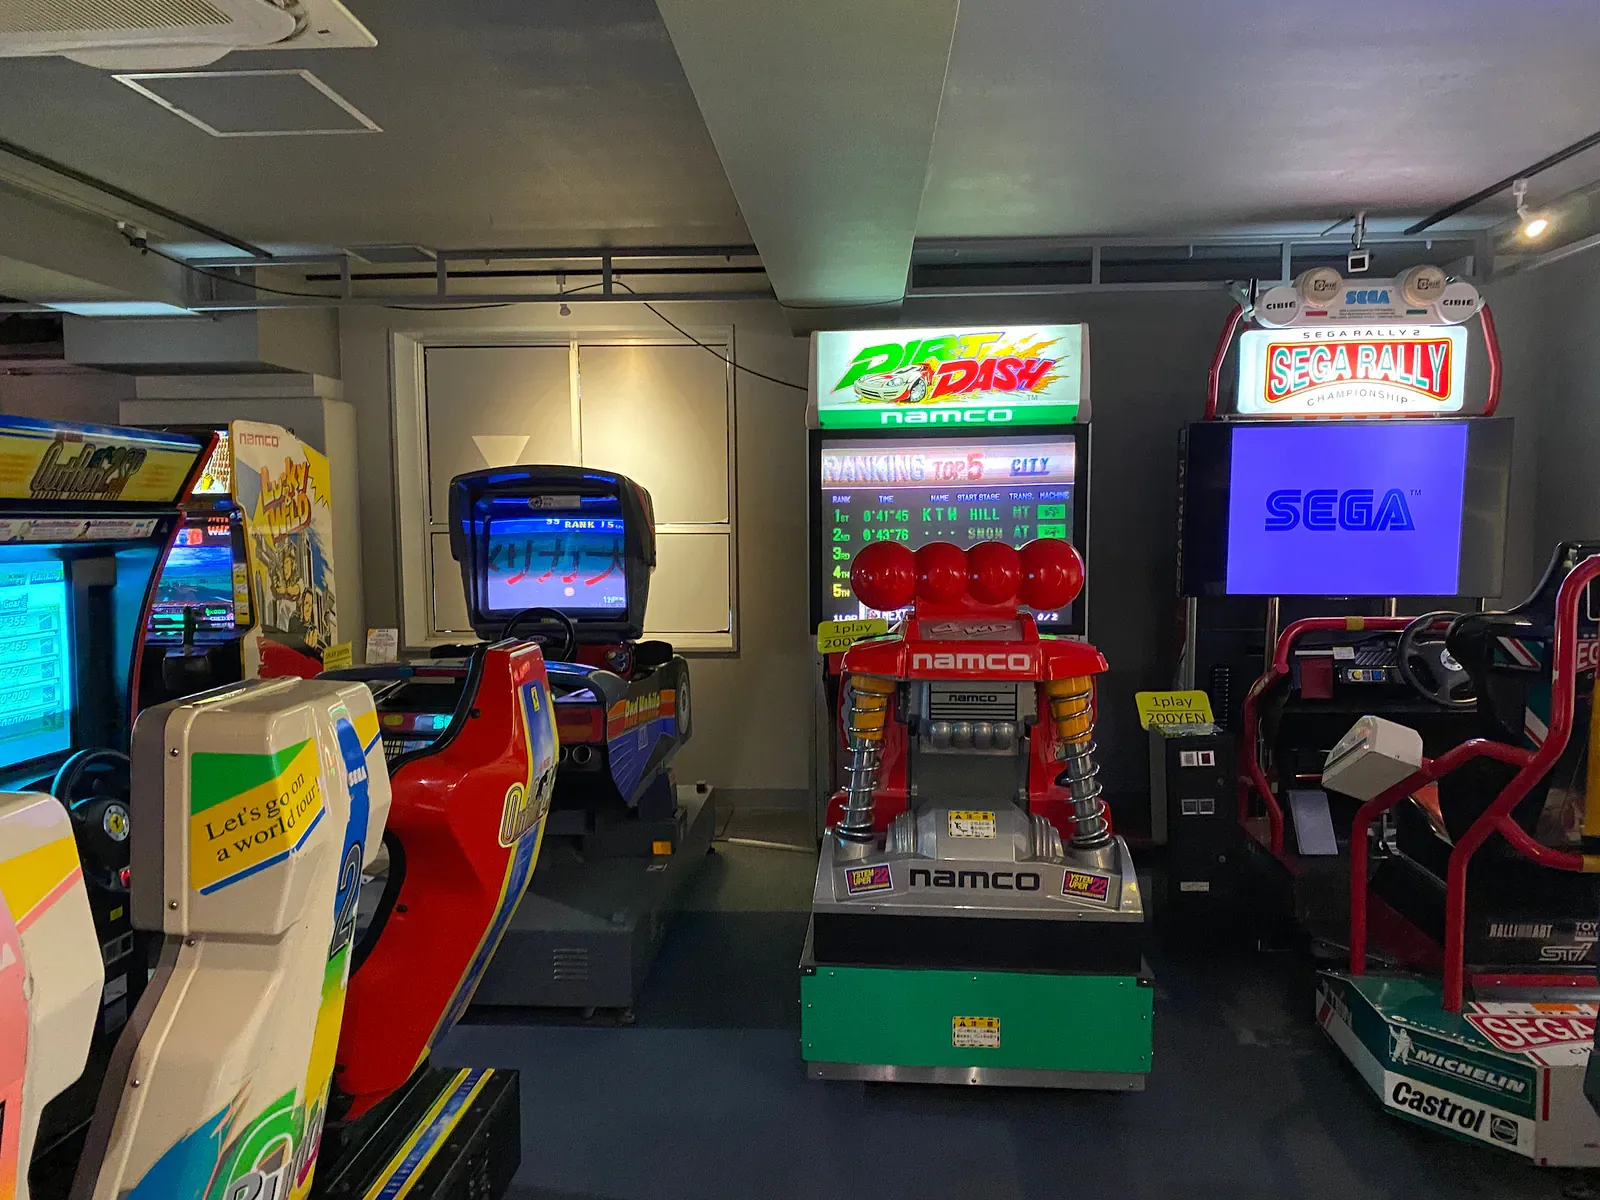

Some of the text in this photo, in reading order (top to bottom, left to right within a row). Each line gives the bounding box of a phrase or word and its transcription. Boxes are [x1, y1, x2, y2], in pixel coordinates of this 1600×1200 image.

[1266, 301, 1296, 309] CIBIE
[1345, 290, 1390, 304] SEGA
[830, 331, 1006, 394] DIRT
[1272, 343, 1447, 395] SEGA RALLY
[931, 356, 1056, 399] DASH
[1307, 389, 1408, 407] CHAMPIONSHIP
[881, 408, 1013, 424] namco
[239, 433, 279, 448] namco
[823, 453, 985, 483] RANKING TOP 5
[1010, 457, 1050, 474] CITY
[832, 491, 1069, 504] RANK TIME NAME START STAGE TRANS. MACHINE
[834, 508, 850, 522] 1ST
[969, 508, 1000, 521] HILL
[1264, 488, 1416, 532] SEGA
[564, 521, 595, 529] RANK
[832, 528, 850, 541] 2ND
[1013, 525, 1030, 538] AT
[833, 546, 850, 560] 3RD
[833, 565, 850, 579] 4TH
[833, 583, 850, 598] 5TH
[882, 610, 907, 621] NEXT
[1037, 612, 1058, 621] 0/2
[833, 623, 872, 634] 1play
[824, 637, 859, 649] 200Y
[913, 653, 1030, 670] namco
[948, 694, 997, 702] namco
[1153, 696, 1192, 708] 1play
[1146, 712, 1206, 724] 200YEN
[204, 772, 305, 841] Let's go on
[216, 777, 320, 862] a world tour!
[874, 867, 889, 883] 22
[909, 868, 1040, 891] namco
[1091, 876, 1107, 893] 22
[331, 840, 362, 957] 2
[1482, 1017, 1595, 1047] SEGA
[1415, 1049, 1526, 1093] MICHELIN
[1392, 1081, 1486, 1133] Castrol
